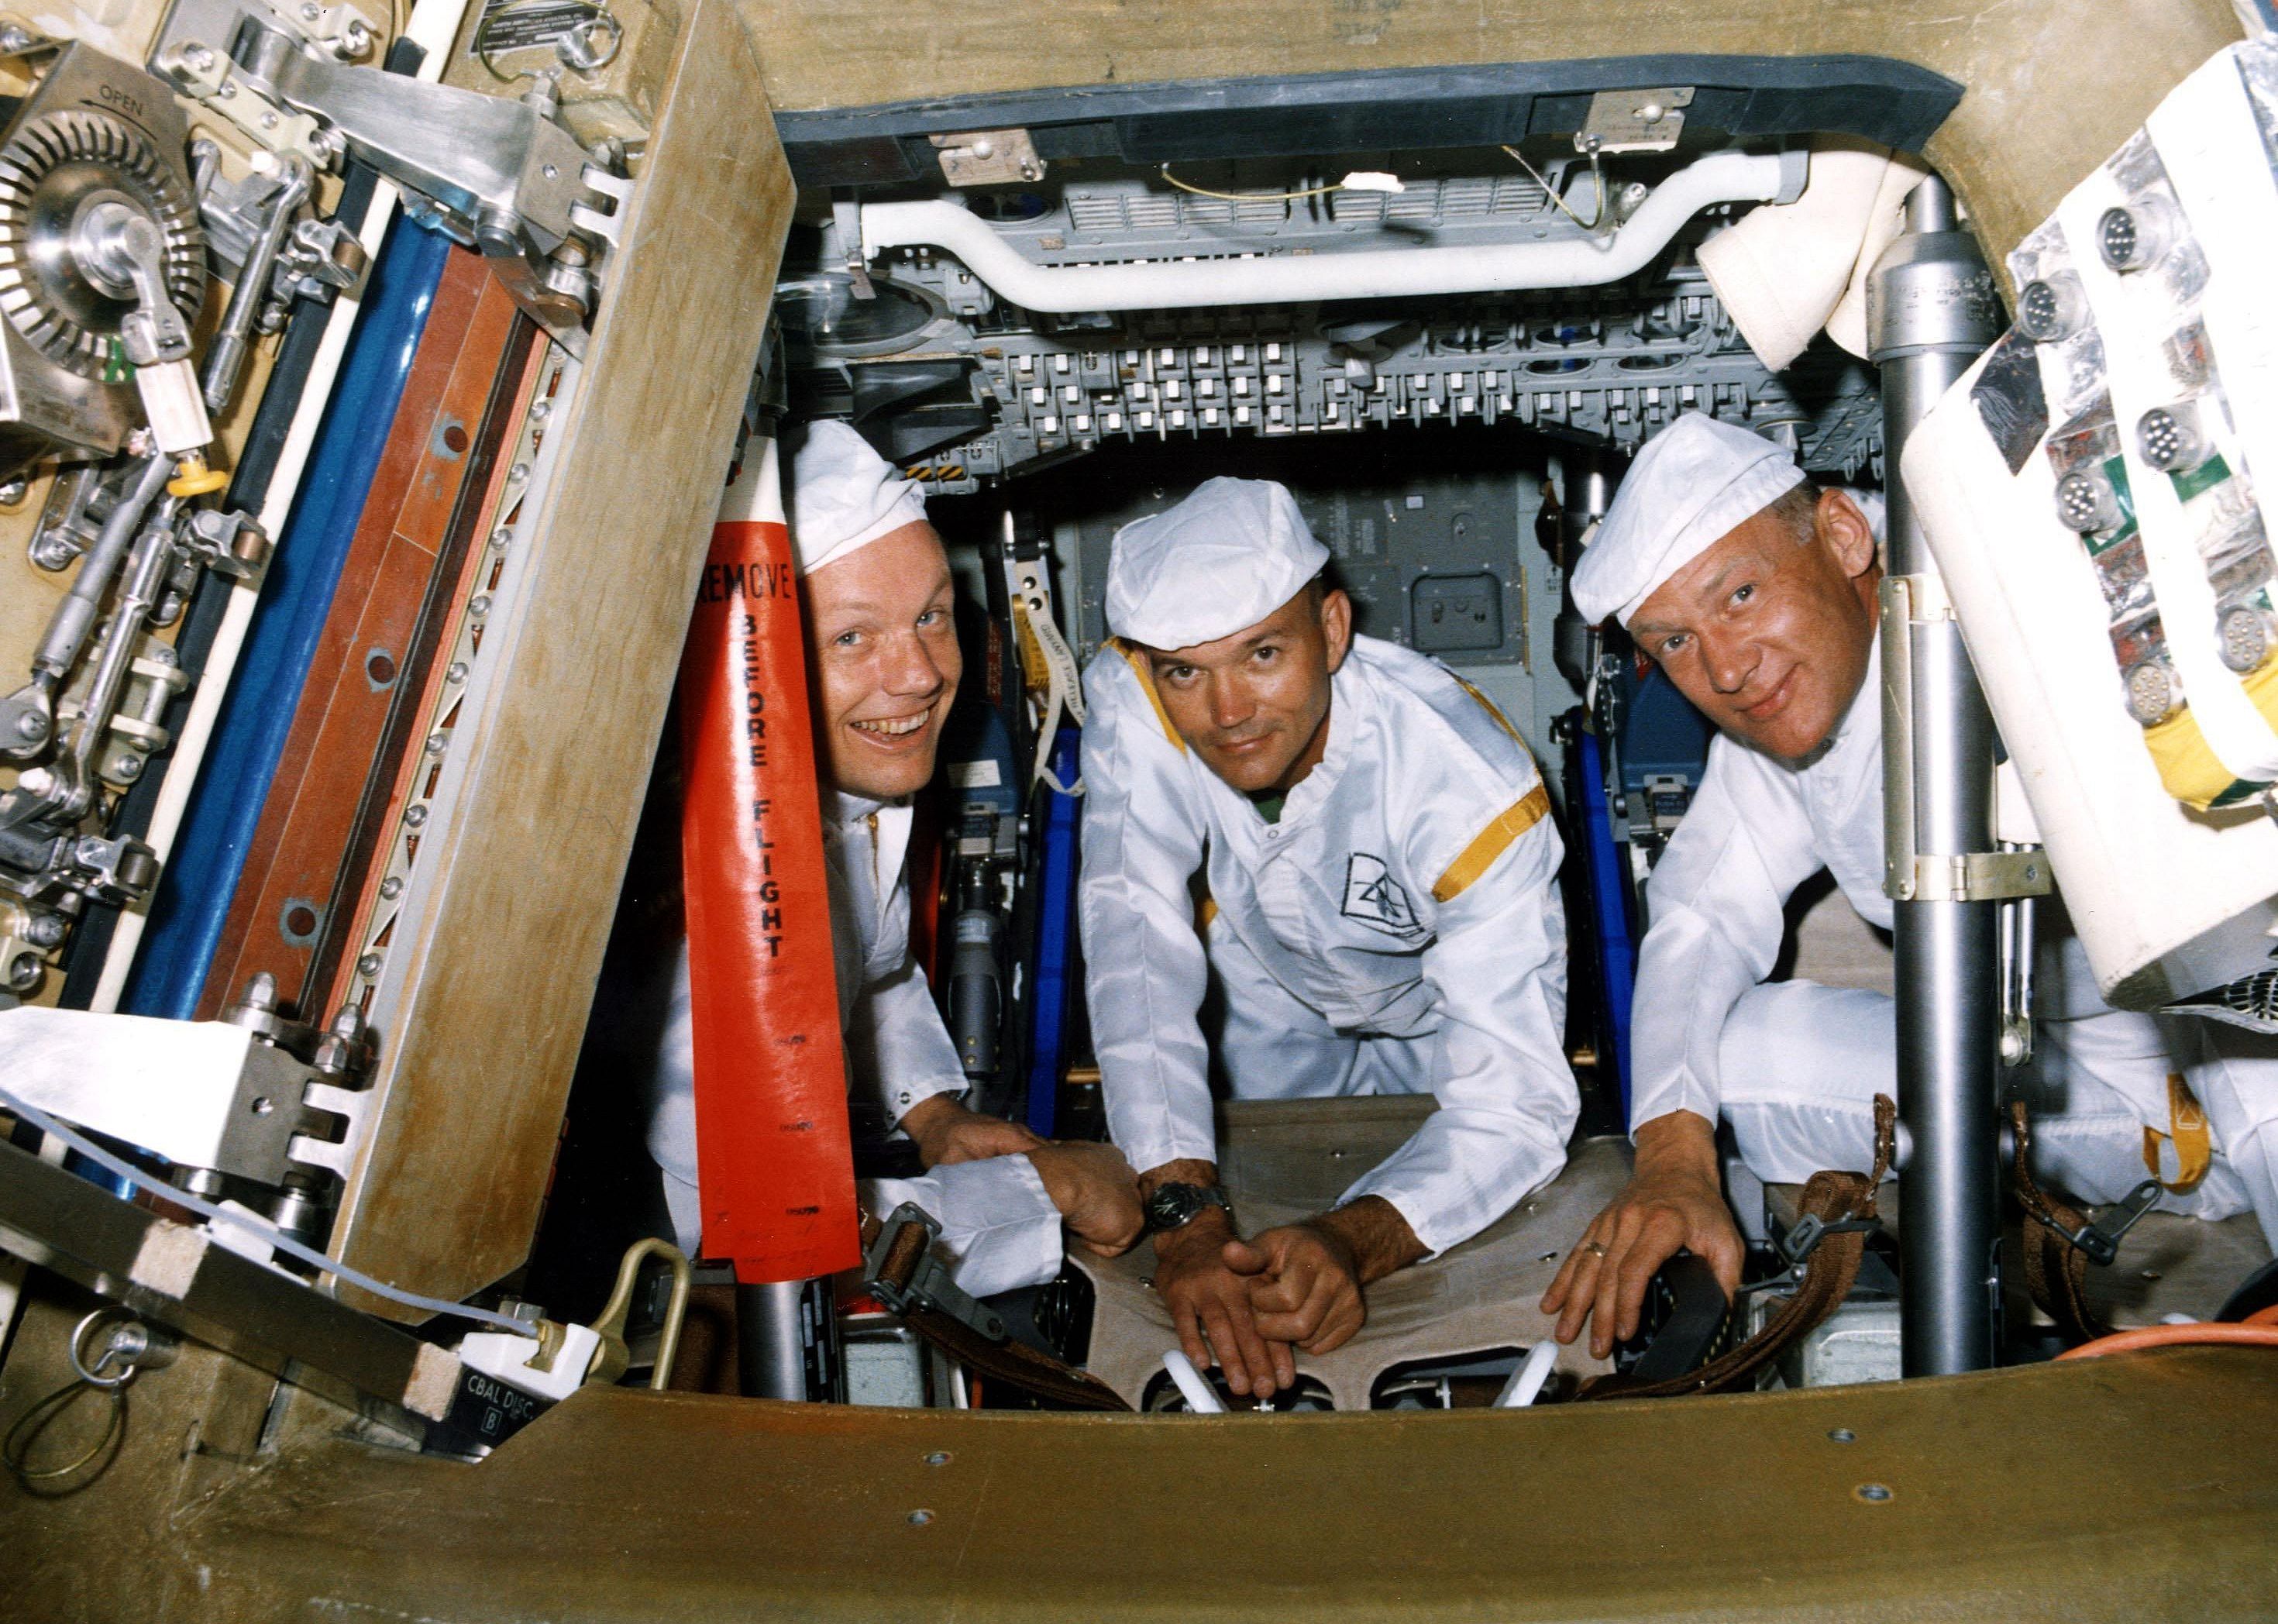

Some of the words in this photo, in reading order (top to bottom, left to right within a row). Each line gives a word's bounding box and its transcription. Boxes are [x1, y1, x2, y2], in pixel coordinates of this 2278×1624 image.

[99, 84, 143, 116] OPEN
[742, 614, 768, 767] BEFORE
[753, 799, 783, 958] FLIGHT
[468, 1375, 501, 1404] CBAL
[486, 1412, 497, 1430] B
